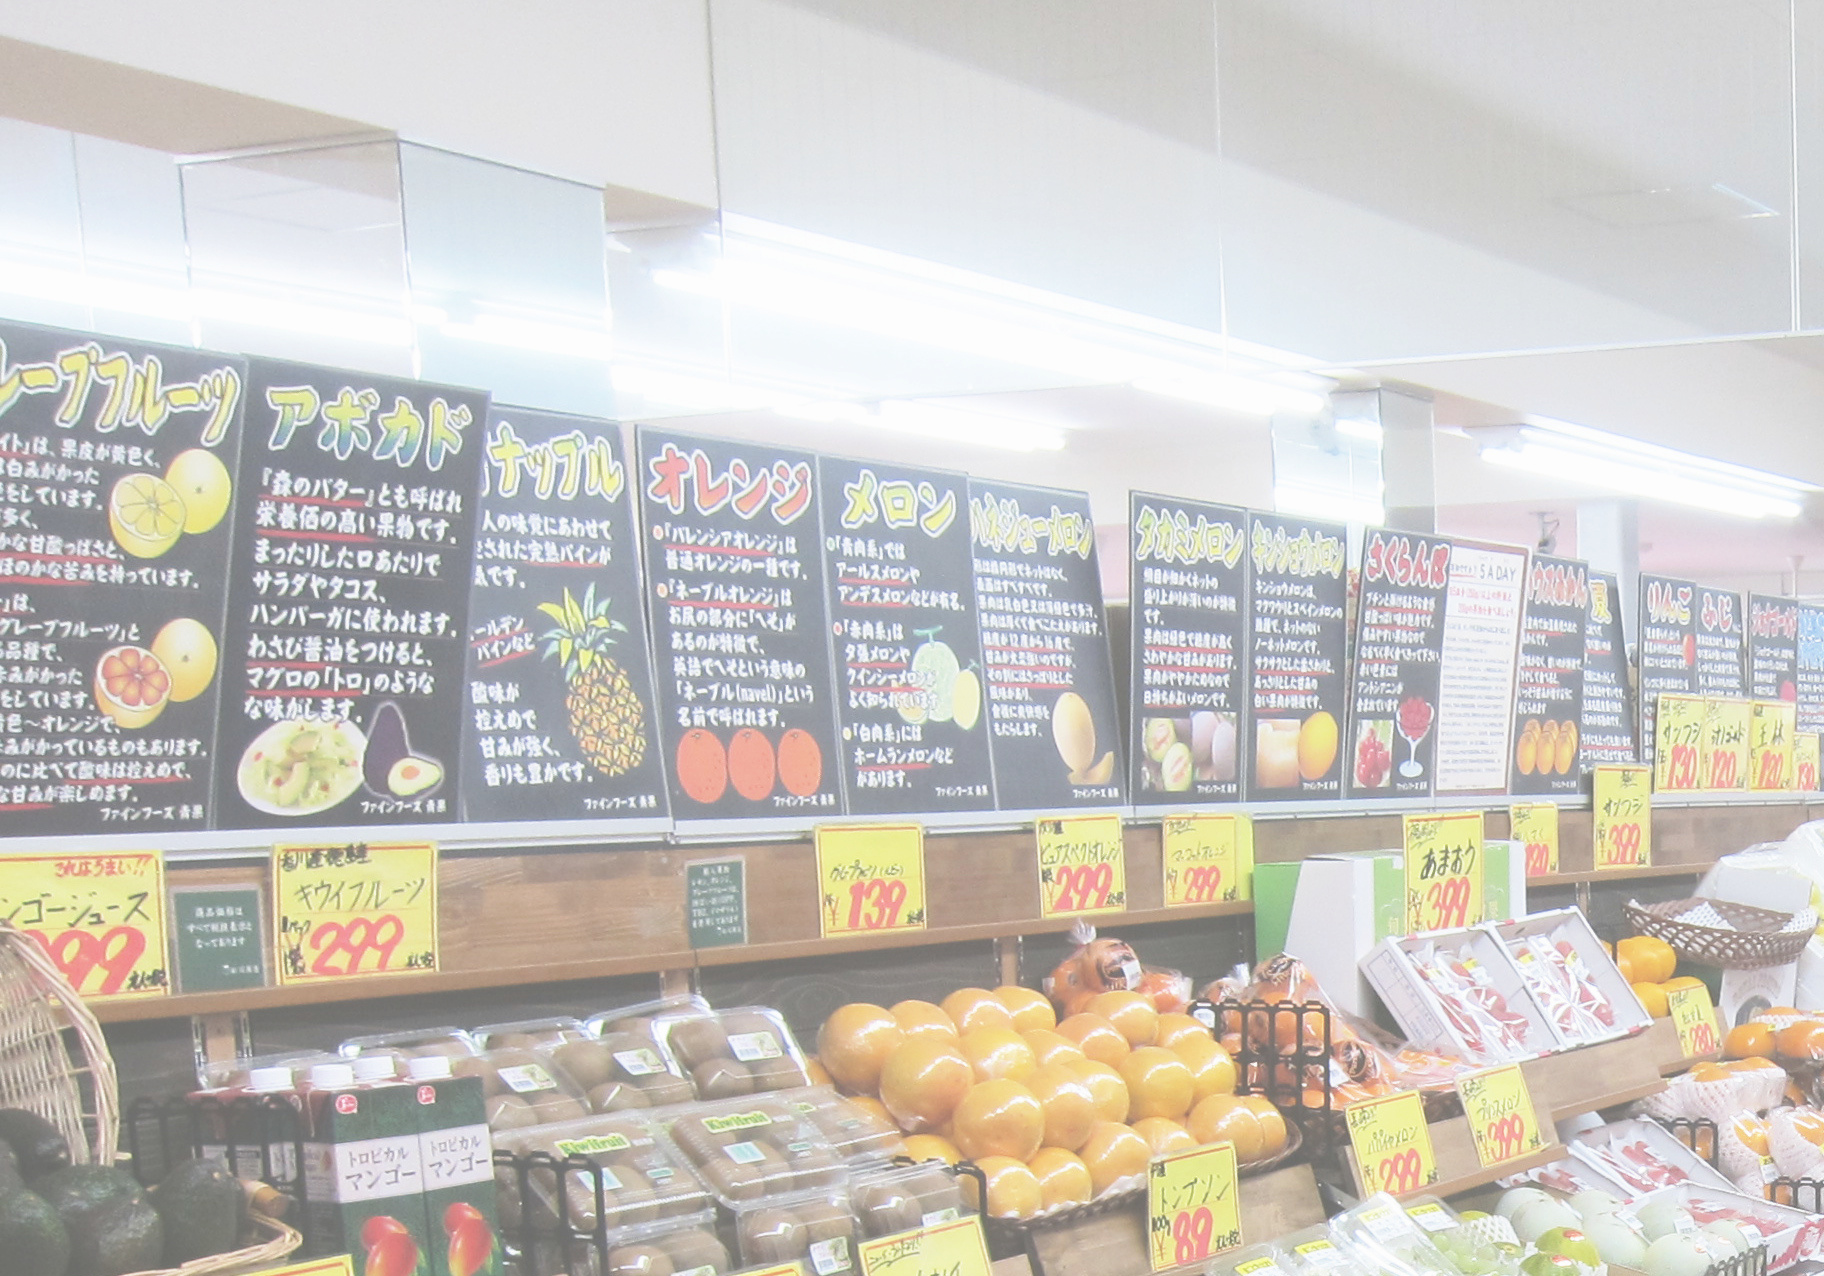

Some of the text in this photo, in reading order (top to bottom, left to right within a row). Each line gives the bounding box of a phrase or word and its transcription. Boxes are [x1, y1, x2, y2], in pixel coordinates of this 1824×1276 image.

[266, 385, 473, 472] アボカド
[482, 421, 624, 502] ナップル
[648, 442, 812, 525] オレンジ
[841, 469, 957, 538] メロン
[254, 537, 442, 577] まったりした口あたりで
[1135, 503, 1243, 571] タカミメロン
[1251, 518, 1344, 581] キンショウメロン
[1365, 531, 1449, 592] さくらんぼ
[252, 570, 386, 603] サラダやタコス、
[248, 633, 433, 667] わさび醤油をつけると、
[247, 667, 434, 695] マグロの「トロ」のような
[471, 681, 520, 705] 酸味が
[244, 695, 362, 723] な味がします。
[475, 709, 537, 732] 控えめで
[1420, 839, 1476, 880] あまおう
[1607, 822, 1641, 865] 399
[294, 878, 426, 910] キウイフルーツ
[850, 878, 907, 930] 139
[1053, 863, 1114, 910] 299
[1184, 865, 1221, 902] 299
[1427, 876, 1471, 931] 399
[310, 914, 404, 976] 299
[349, 1147, 410, 1168] トロピカル
[430, 1135, 481, 1158] トロピカル
[1487, 1112, 1525, 1162] 399
[345, 1169, 417, 1192] マンゴー
[428, 1156, 489, 1179] マンゴー
[1379, 1147, 1422, 1196] 299
[1173, 1207, 1214, 1266] 89
